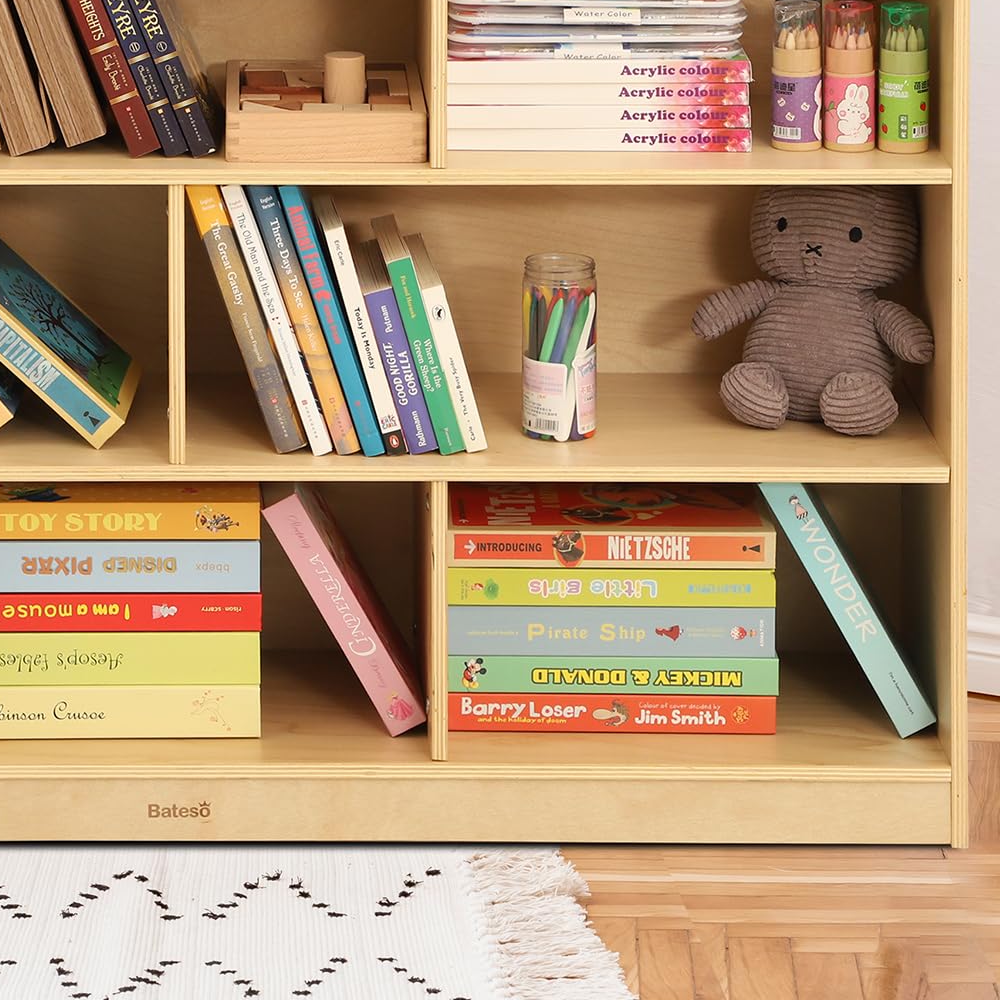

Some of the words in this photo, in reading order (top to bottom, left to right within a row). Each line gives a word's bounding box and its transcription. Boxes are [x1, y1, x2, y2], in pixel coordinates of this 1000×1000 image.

[620, 65, 675, 77] Acrylic
[679, 65, 728, 75] colour
[618, 87, 673, 99] Acrylic
[677, 87, 726, 97] colour
[620, 110, 675, 122] Acrylic
[679, 110, 728, 120] colour
[621, 133, 676, 145] Acrylic
[680, 133, 729, 143] colour
[237, 212, 247, 230] The
[242, 230, 254, 246] Old
[270, 217, 285, 249] Three
[248, 246, 259, 265] Man
[287, 205, 316, 251] Animal
[302, 252, 325, 289] Farm
[211, 219, 222, 240] The
[217, 242, 234, 270] Great
[227, 271, 244, 306] Gatsby
[280, 249, 293, 275] Days
[255, 265, 266, 282] and
[289, 275, 300, 290] To
[259, 282, 271, 297] the
[264, 297, 275, 314] Sea
[293, 290, 304, 309] See
[354, 307, 364, 331] Today
[381, 305, 394, 334] Putnam
[360, 331, 367, 339] Is
[363, 339, 376, 370] Monday
[423, 338, 434, 365] Where
[397, 350, 418, 396] GORILLA
[413, 340, 424, 364] Green
[421, 364, 435, 393] Sheep?
[430, 364, 438, 372] Is
[433, 373, 442, 389] the
[393, 379, 409, 406] GOOD
[411, 410, 427, 448] Rathmann
[0, 512, 58, 532] TOY
[65, 512, 162, 532] STORY
[476, 542, 542, 552] INTRODUCING
[21, 556, 93, 576] PIXAR
[528, 579, 583, 598] girls
[590, 579, 658, 598] Little
[800, 518, 878, 643] WONDER
[1, 603, 73, 619] mouse
[76, 603, 88, 616] a
[92, 603, 120, 616] am
[527, 623, 589, 641] Pirate
[600, 623, 646, 642] Ship
[0, 652, 49, 672] fables
[56, 649, 124, 671] Aesop's
[531, 667, 627, 685] DONALD
[631, 669, 651, 686] &
[653, 669, 743, 687] MICKEY
[53, 701, 106, 720] Crusoe
[461, 696, 526, 718] Barry
[529, 701, 587, 718] Loser
[634, 709, 668, 725] Jim
[671, 709, 726, 725] Smith
[148, 802, 211, 818] Bateso
